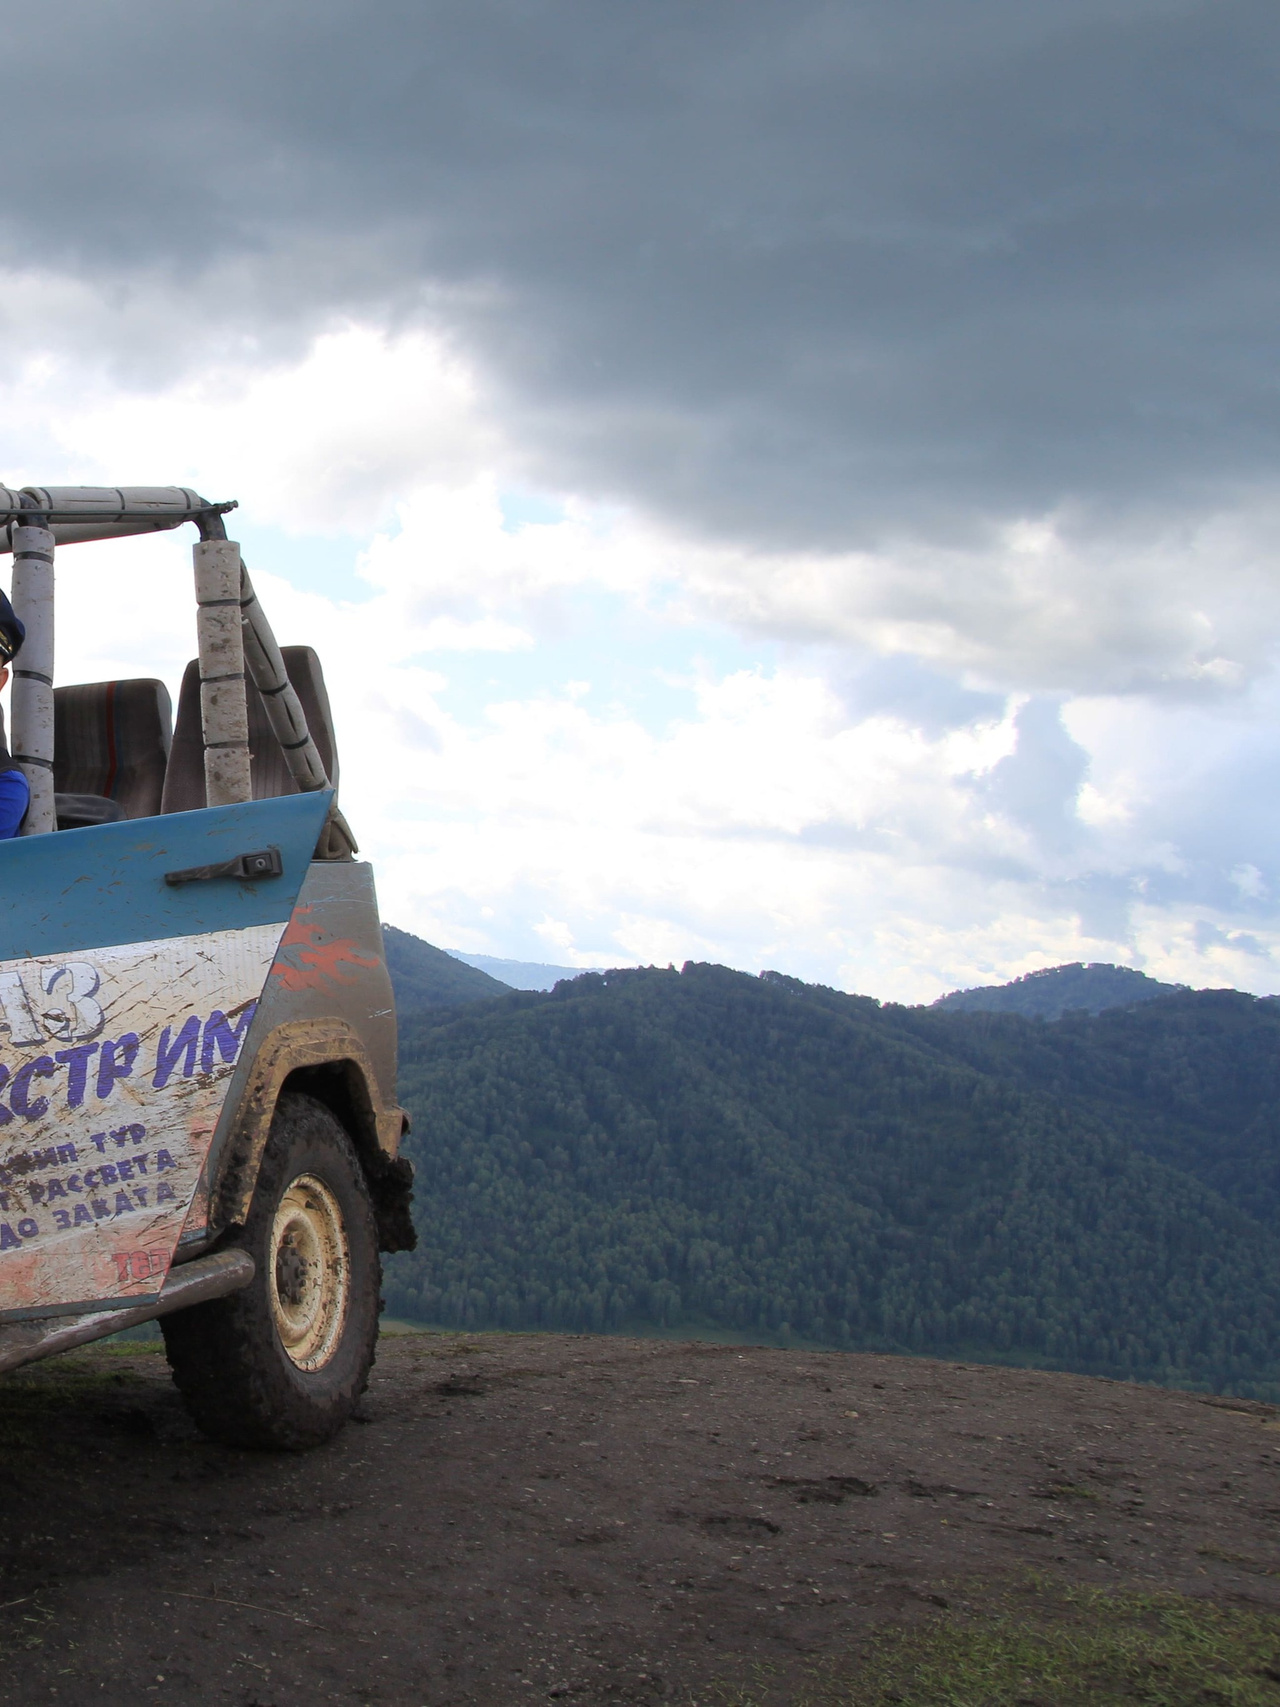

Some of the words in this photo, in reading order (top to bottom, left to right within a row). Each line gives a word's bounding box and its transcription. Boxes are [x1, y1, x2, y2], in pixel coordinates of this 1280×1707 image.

[90, 1123, 146, 1153] ТУР
[27, 1149, 177, 1204] РАССВЕТА
[0, 1218, 40, 1250] ДО
[53, 1182, 177, 1230] ЗАКАТА
